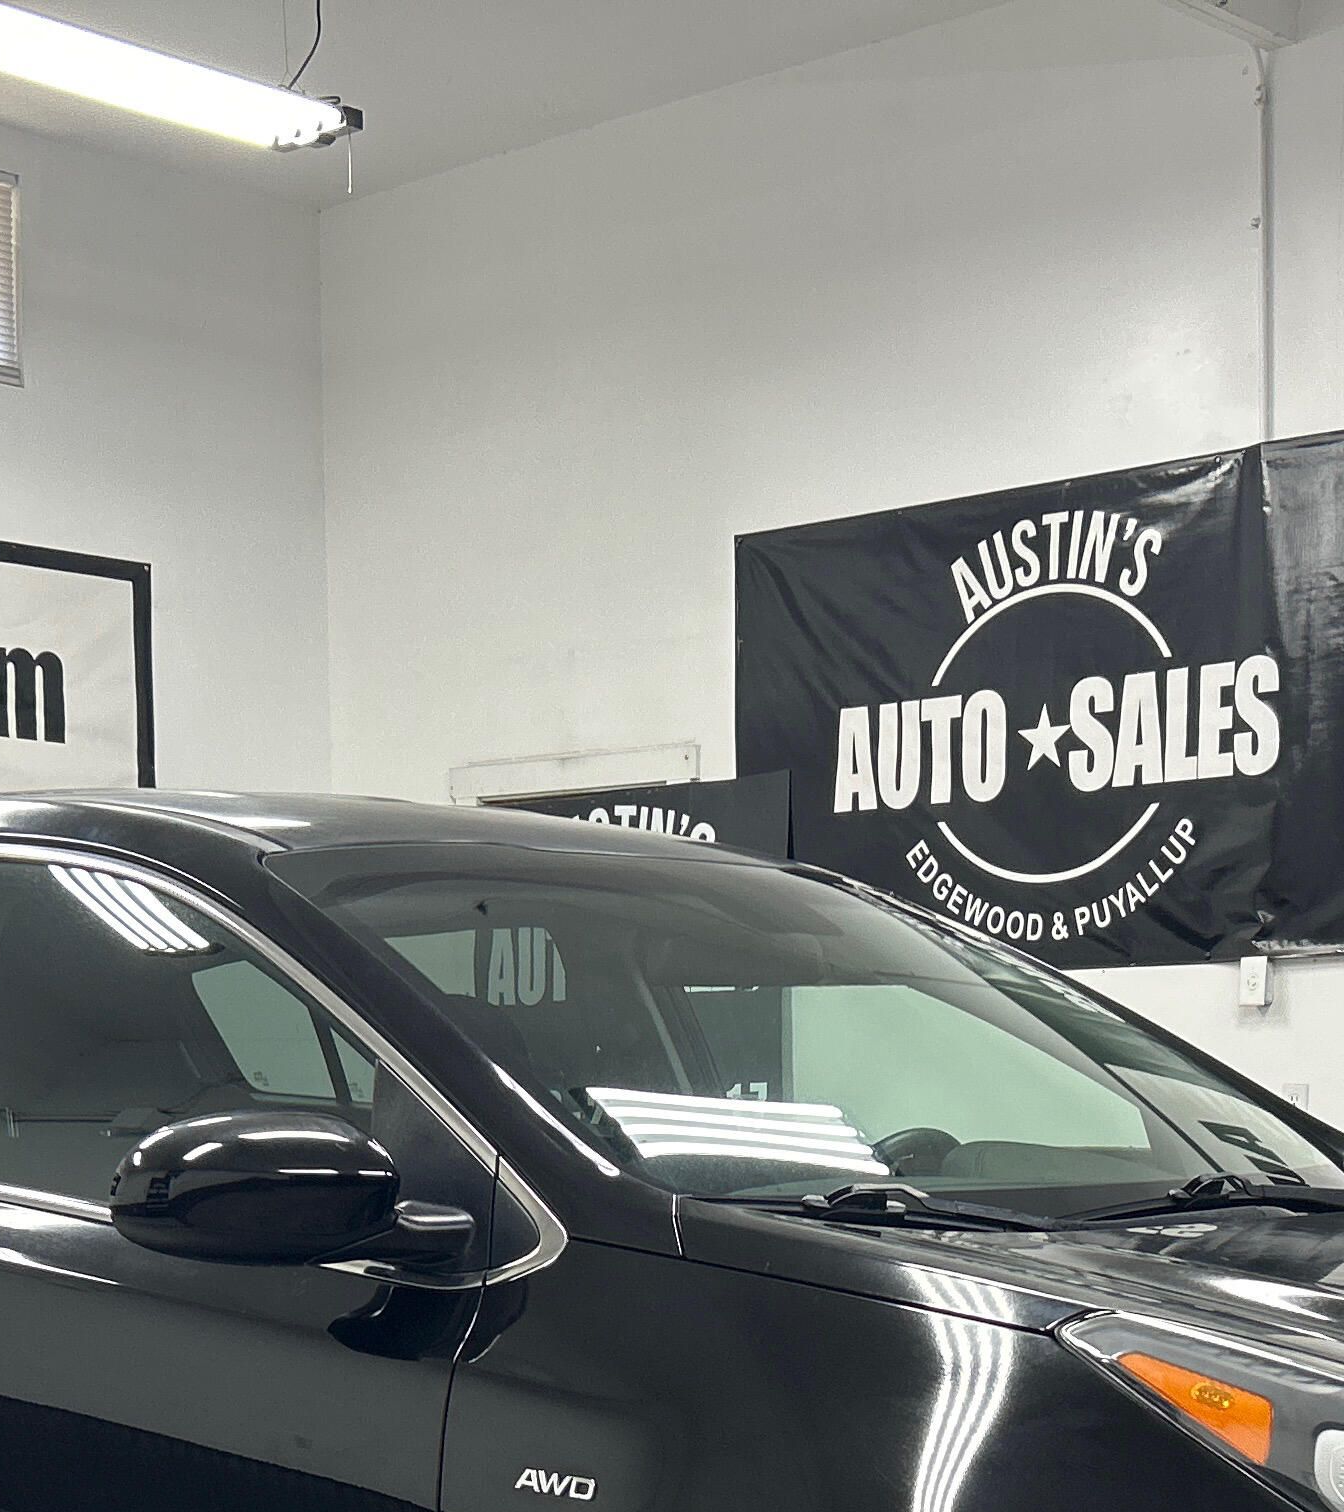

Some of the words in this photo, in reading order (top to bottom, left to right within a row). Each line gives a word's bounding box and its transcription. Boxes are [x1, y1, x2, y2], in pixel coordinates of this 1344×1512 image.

[950, 510, 1162, 623] AUSTIN'S
[833, 689, 1007, 814] AUTO
[1068, 655, 1280, 793] SALES
[905, 838, 1043, 942] EDGEWOOD
[1053, 912, 1070, 941] &
[1075, 817, 1199, 936] PUYALLUP
[515, 1468, 597, 1500] AWD
